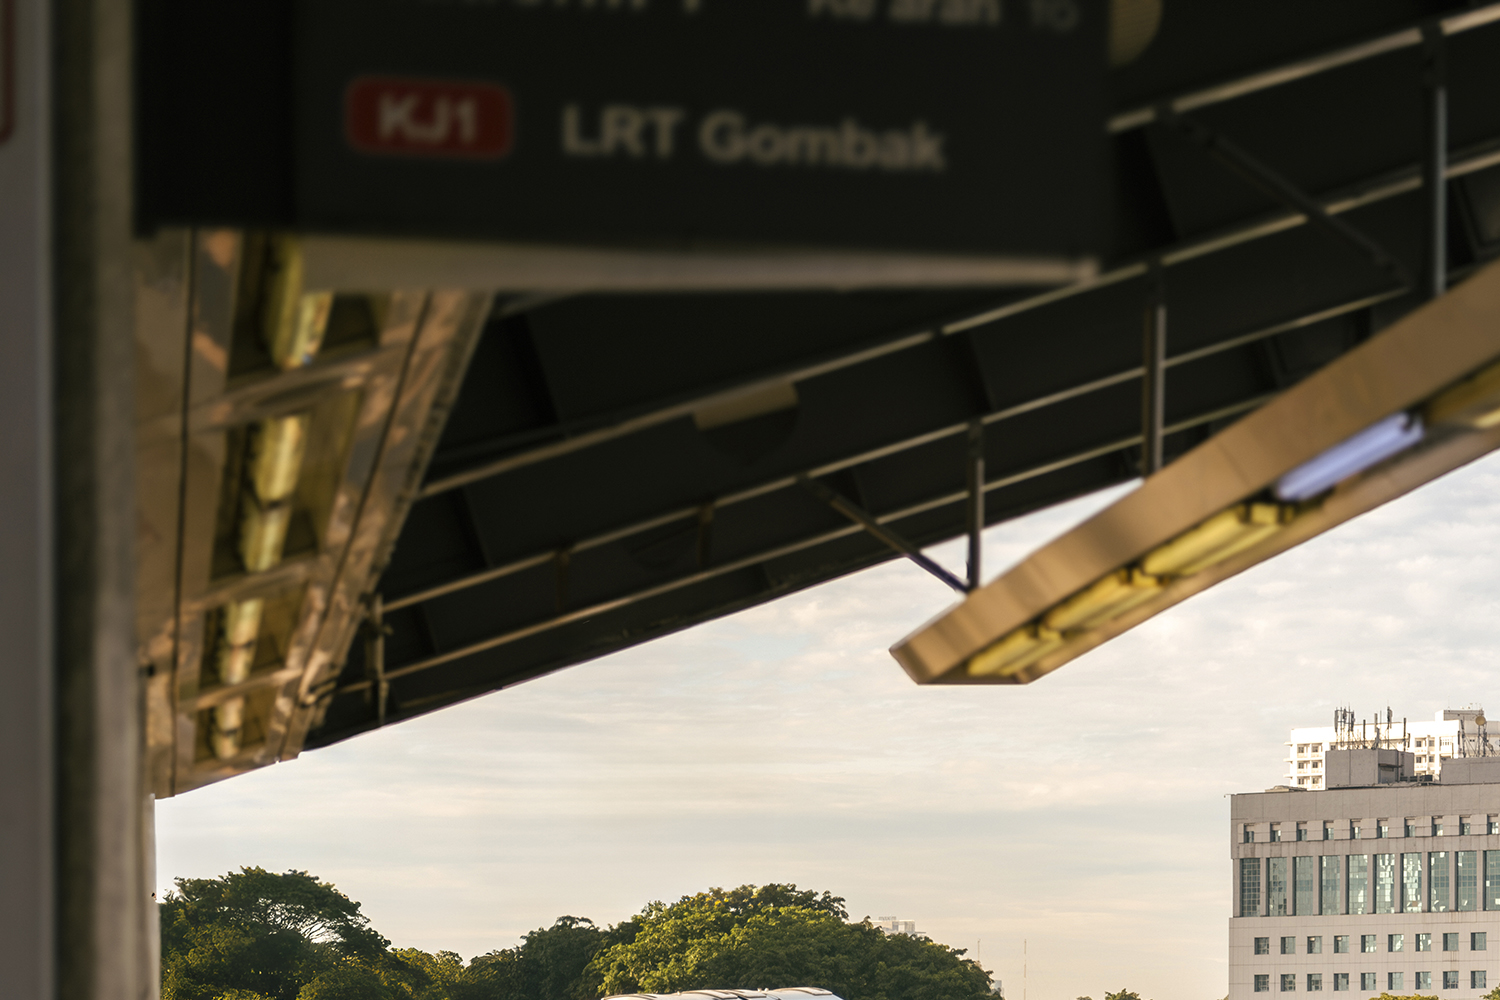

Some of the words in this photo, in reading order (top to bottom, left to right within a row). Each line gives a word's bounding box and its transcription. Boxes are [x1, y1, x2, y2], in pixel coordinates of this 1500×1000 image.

[377, 94, 477, 145] KJ1
[560, 103, 684, 158] LRT
[699, 110, 946, 172] Gombak
